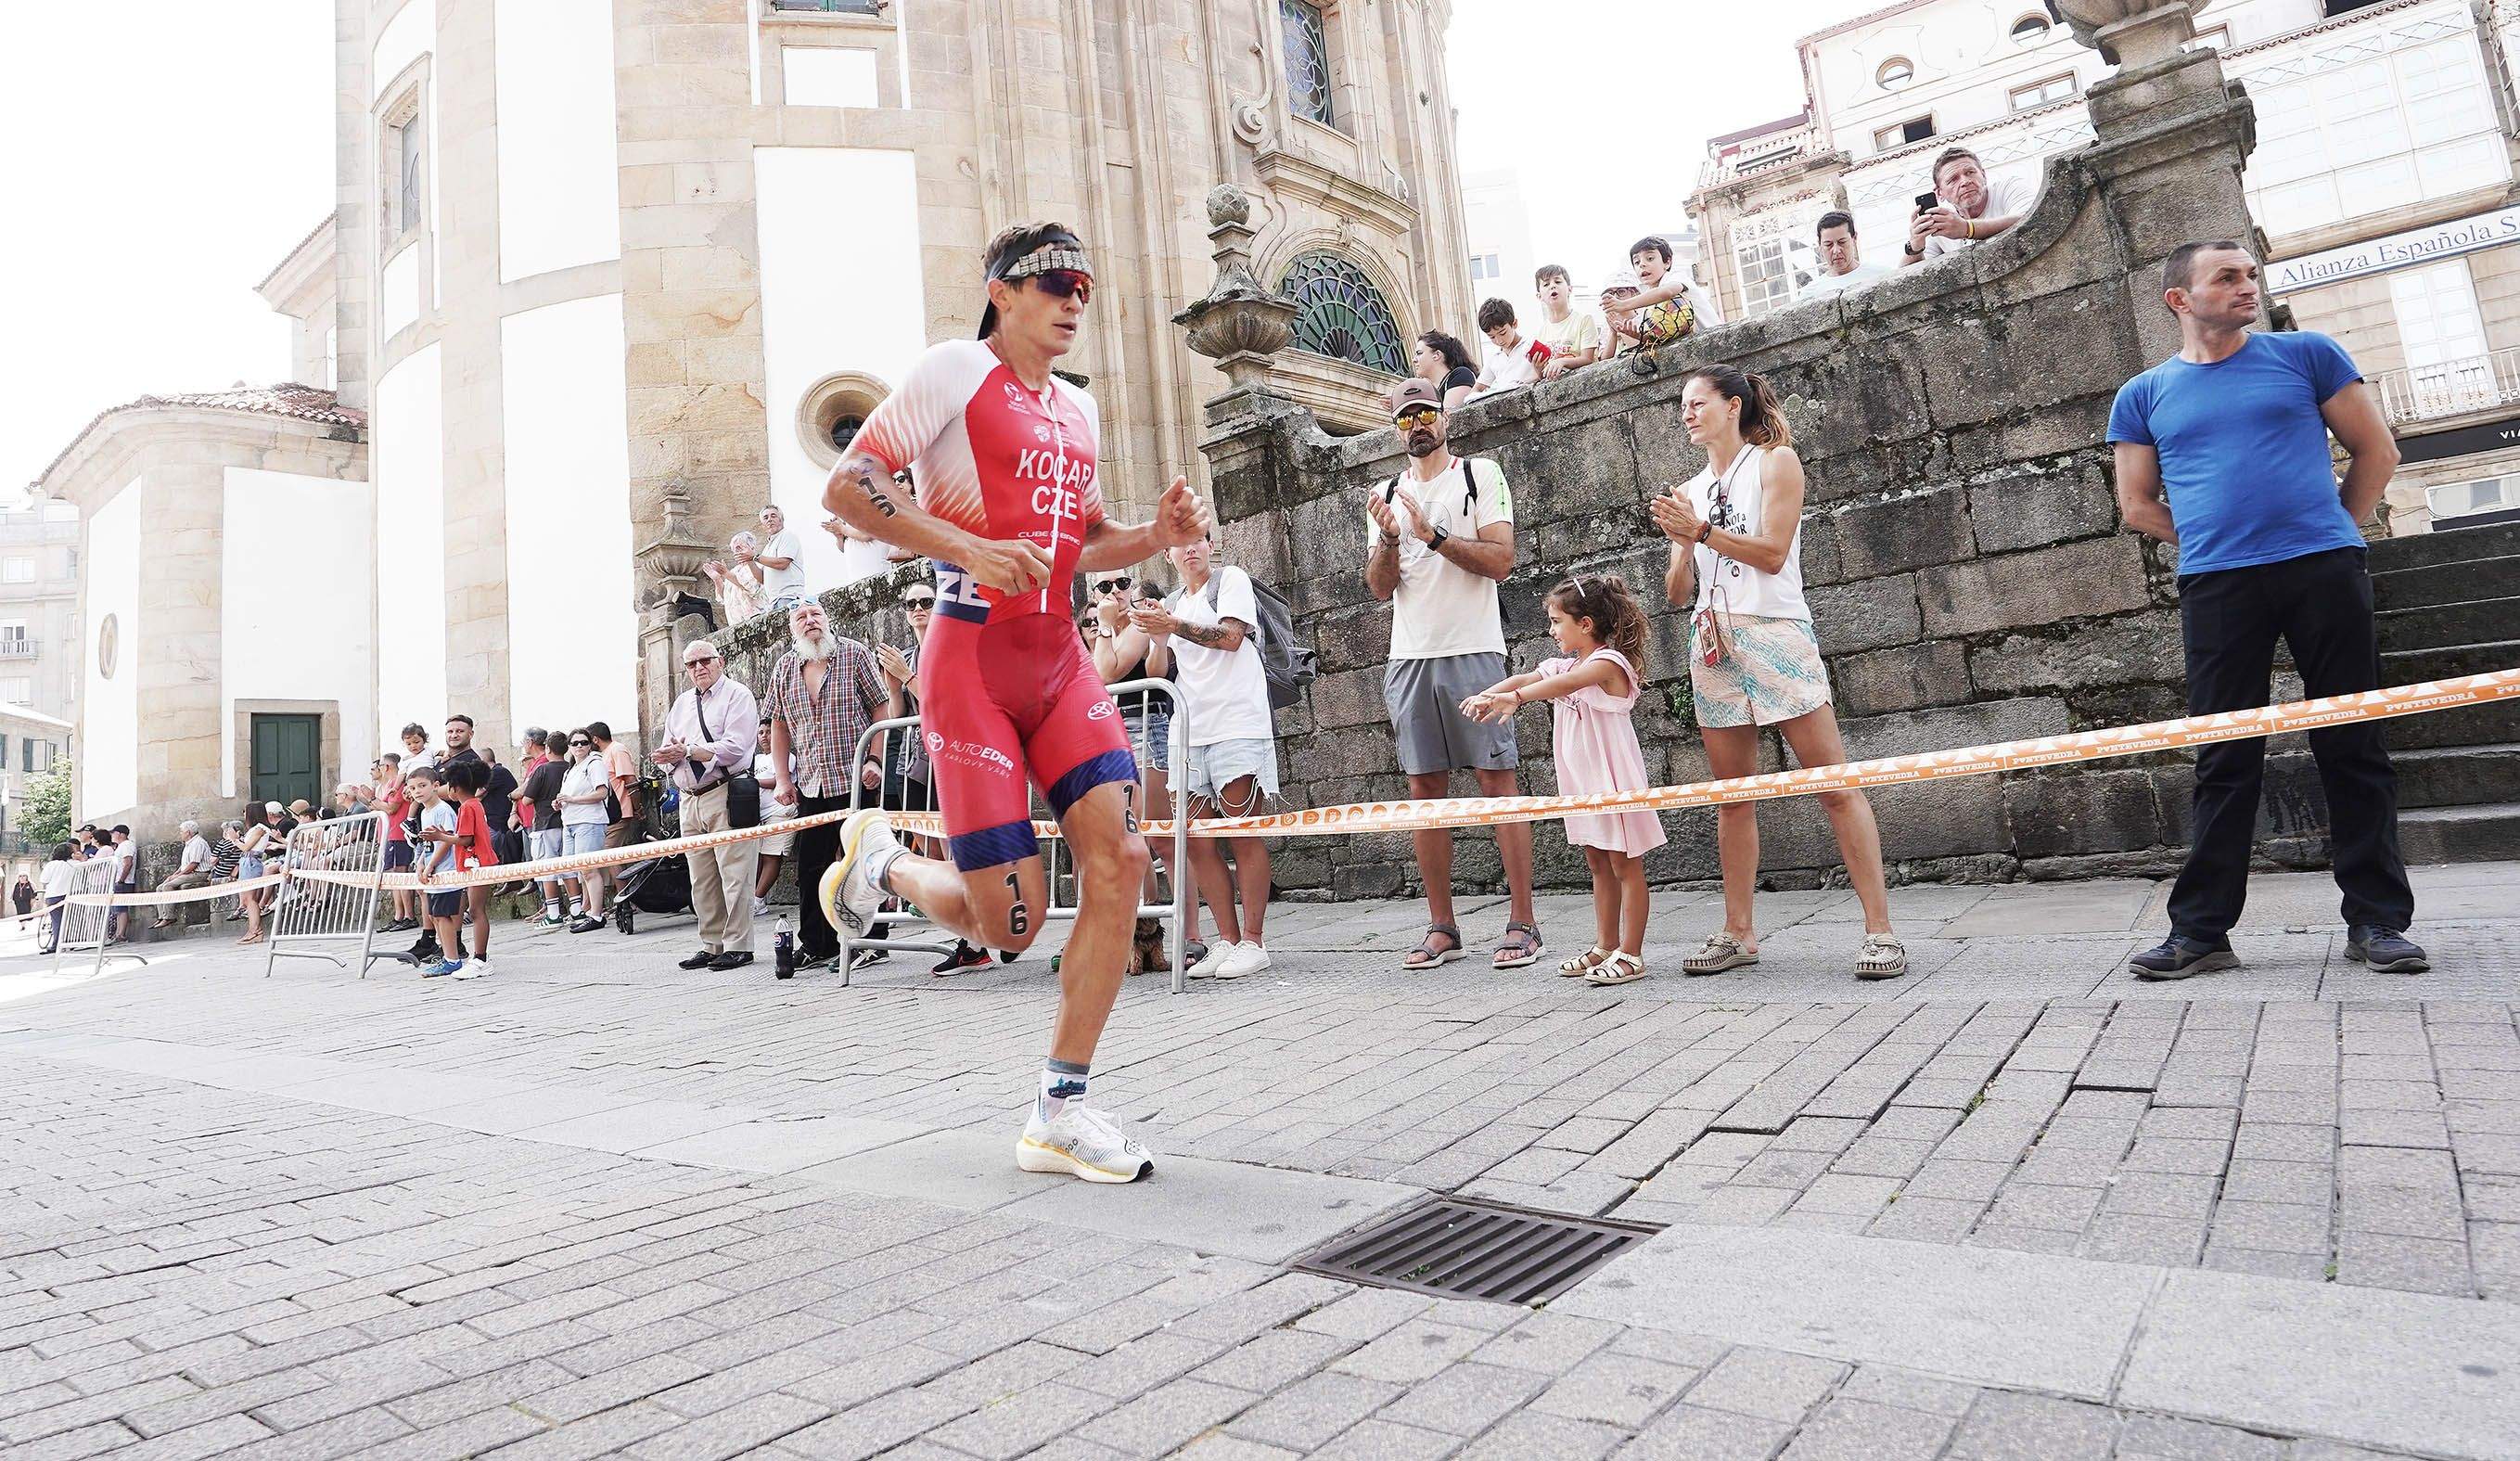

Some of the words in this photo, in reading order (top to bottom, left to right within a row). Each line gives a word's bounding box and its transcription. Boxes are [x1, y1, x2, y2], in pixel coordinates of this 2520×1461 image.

[2281, 255, 2370, 285] Alianza
[2379, 224, 2492, 263] Española
[2500, 215, 2520, 234] S
[1015, 448, 1093, 493] KOCAR
[858, 475, 898, 519] 16
[1031, 485, 1078, 520] CZE
[1729, 524, 1747, 534] TOR
[949, 740, 1015, 771] AUTOEDER
[1122, 784, 1138, 835] 16
[1004, 871, 1030, 936] 16
